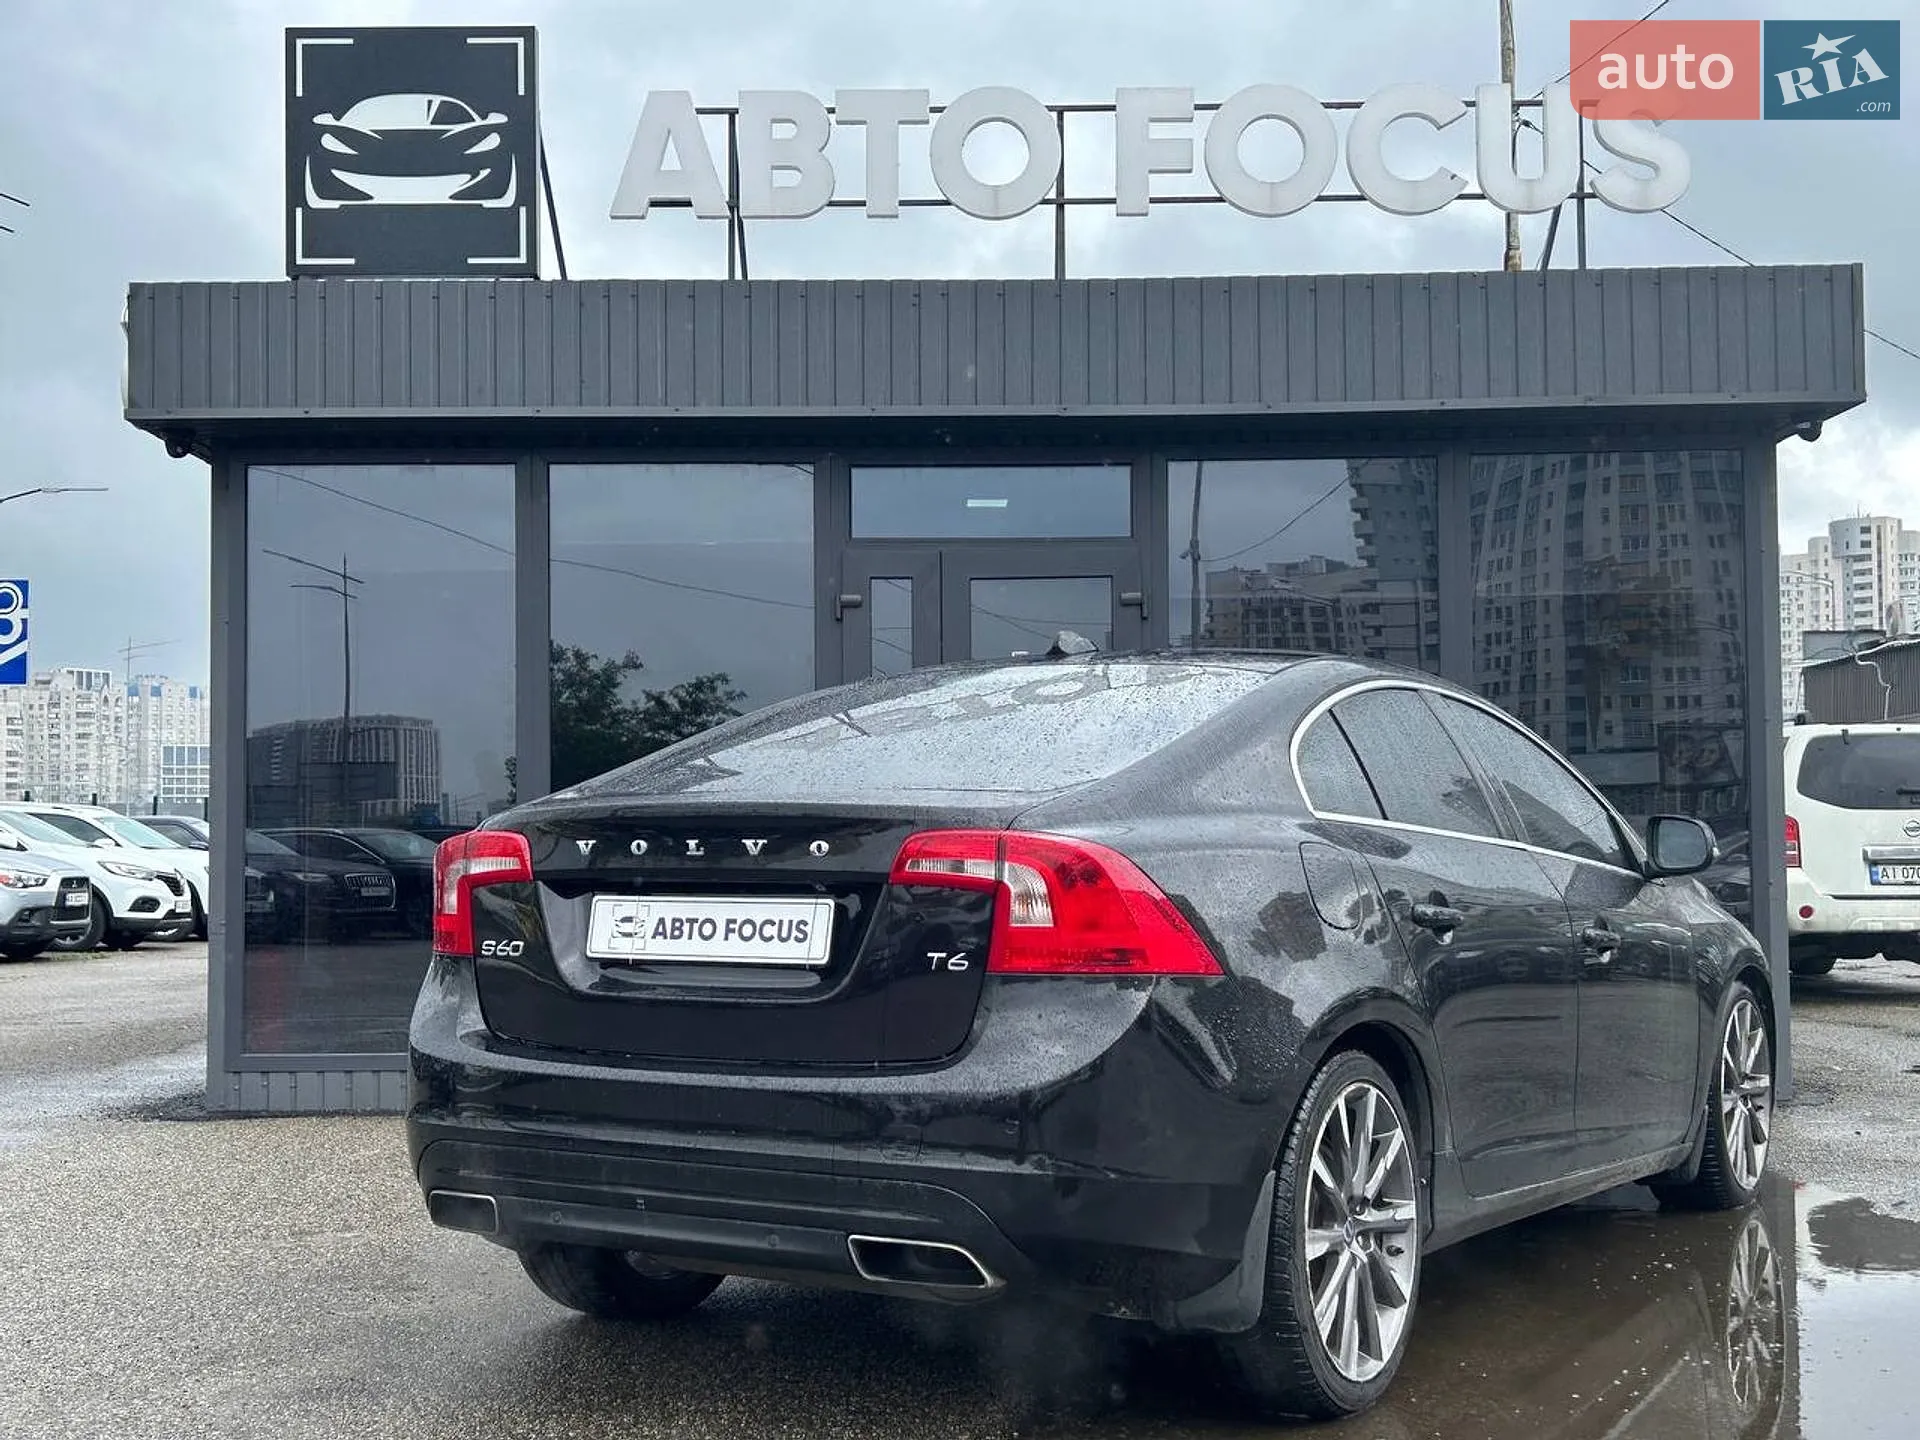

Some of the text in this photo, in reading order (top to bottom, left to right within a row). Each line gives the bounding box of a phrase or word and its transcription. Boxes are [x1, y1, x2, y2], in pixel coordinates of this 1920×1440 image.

[1115, 83, 1692, 217] FOCUS
[576, 839, 830, 856] VOLVO
[723, 918, 809, 943] FOCUS
[481, 940, 525, 957] S60
[927, 952, 969, 971] T6
